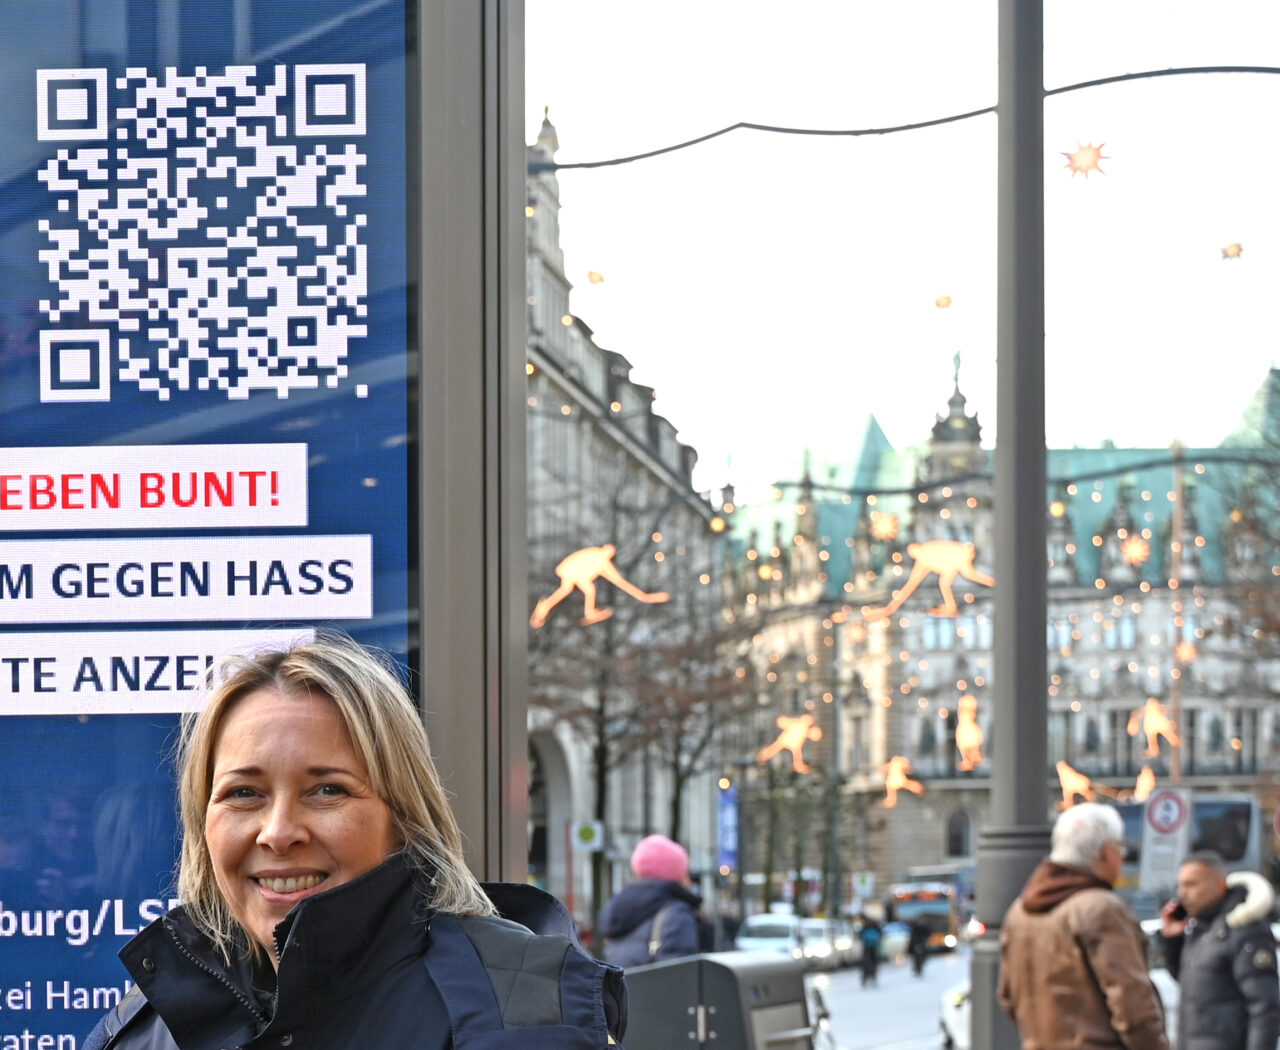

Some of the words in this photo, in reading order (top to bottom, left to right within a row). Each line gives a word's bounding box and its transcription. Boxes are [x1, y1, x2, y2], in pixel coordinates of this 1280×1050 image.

[139, 470, 279, 508] BUNT!
[52, 561, 209, 598] GEGEN
[226, 559, 354, 596] HASS
[73, 655, 215, 692] ANZEI
